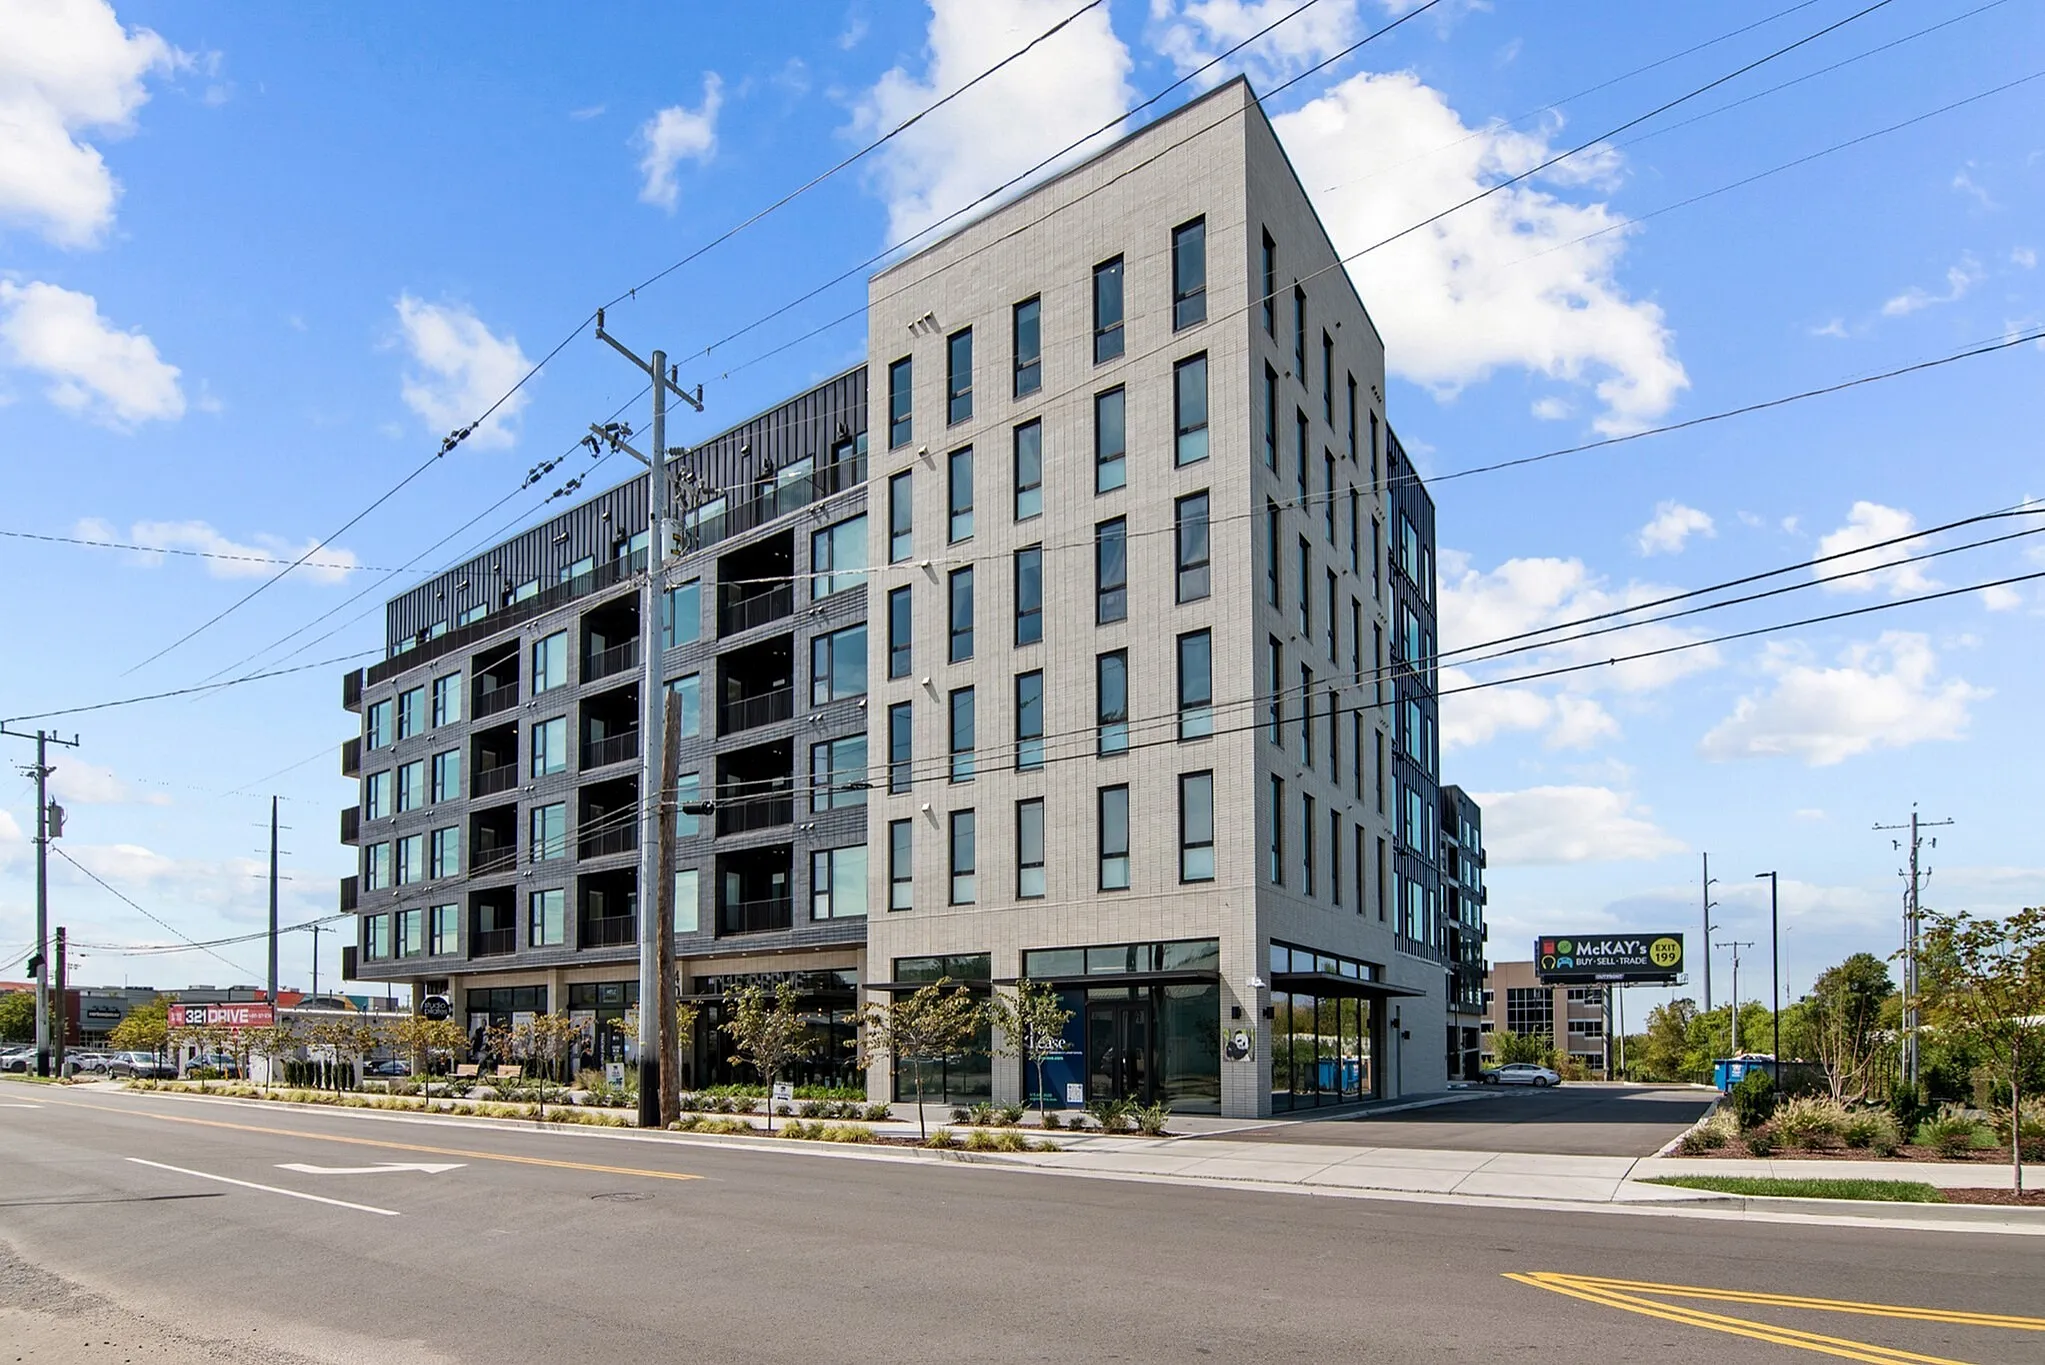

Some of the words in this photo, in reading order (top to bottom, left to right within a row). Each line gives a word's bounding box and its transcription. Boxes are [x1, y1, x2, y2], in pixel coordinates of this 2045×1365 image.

[1576, 940, 1647, 956] McKAY's
[1655, 944, 1676, 952] EXIT
[1576, 958, 1592, 966] BUY
[1597, 957, 1616, 966] SELL
[1619, 957, 1648, 965] TRADE
[1655, 952, 1676, 962] 199
[185, 1009, 206, 1024] 321
[207, 1009, 249, 1024] DRIVE
